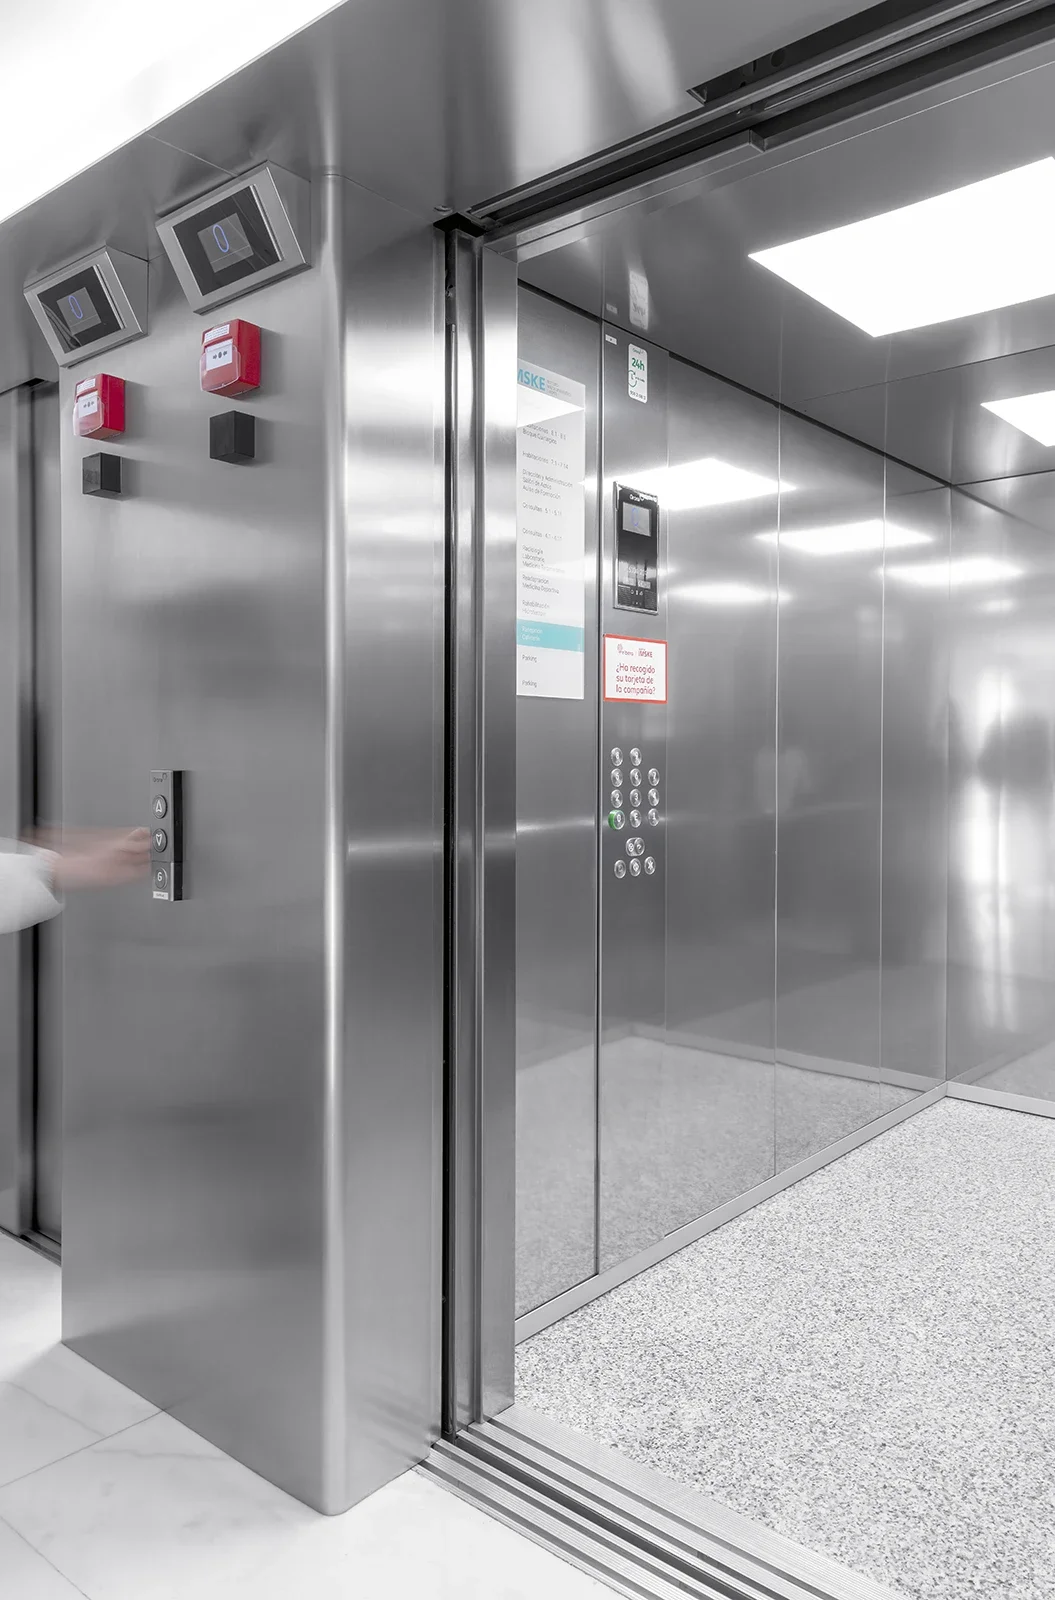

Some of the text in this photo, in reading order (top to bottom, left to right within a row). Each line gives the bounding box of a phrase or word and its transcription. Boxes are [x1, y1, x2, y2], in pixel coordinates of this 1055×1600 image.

[212, 223, 230, 253] 0
[68, 295, 84, 319] 0
[631, 357, 645, 371] 24h
[615, 662, 656, 676] ¿Ha recogido
[615, 674, 654, 686] su tarjeta de
[615, 683, 623, 694] la
